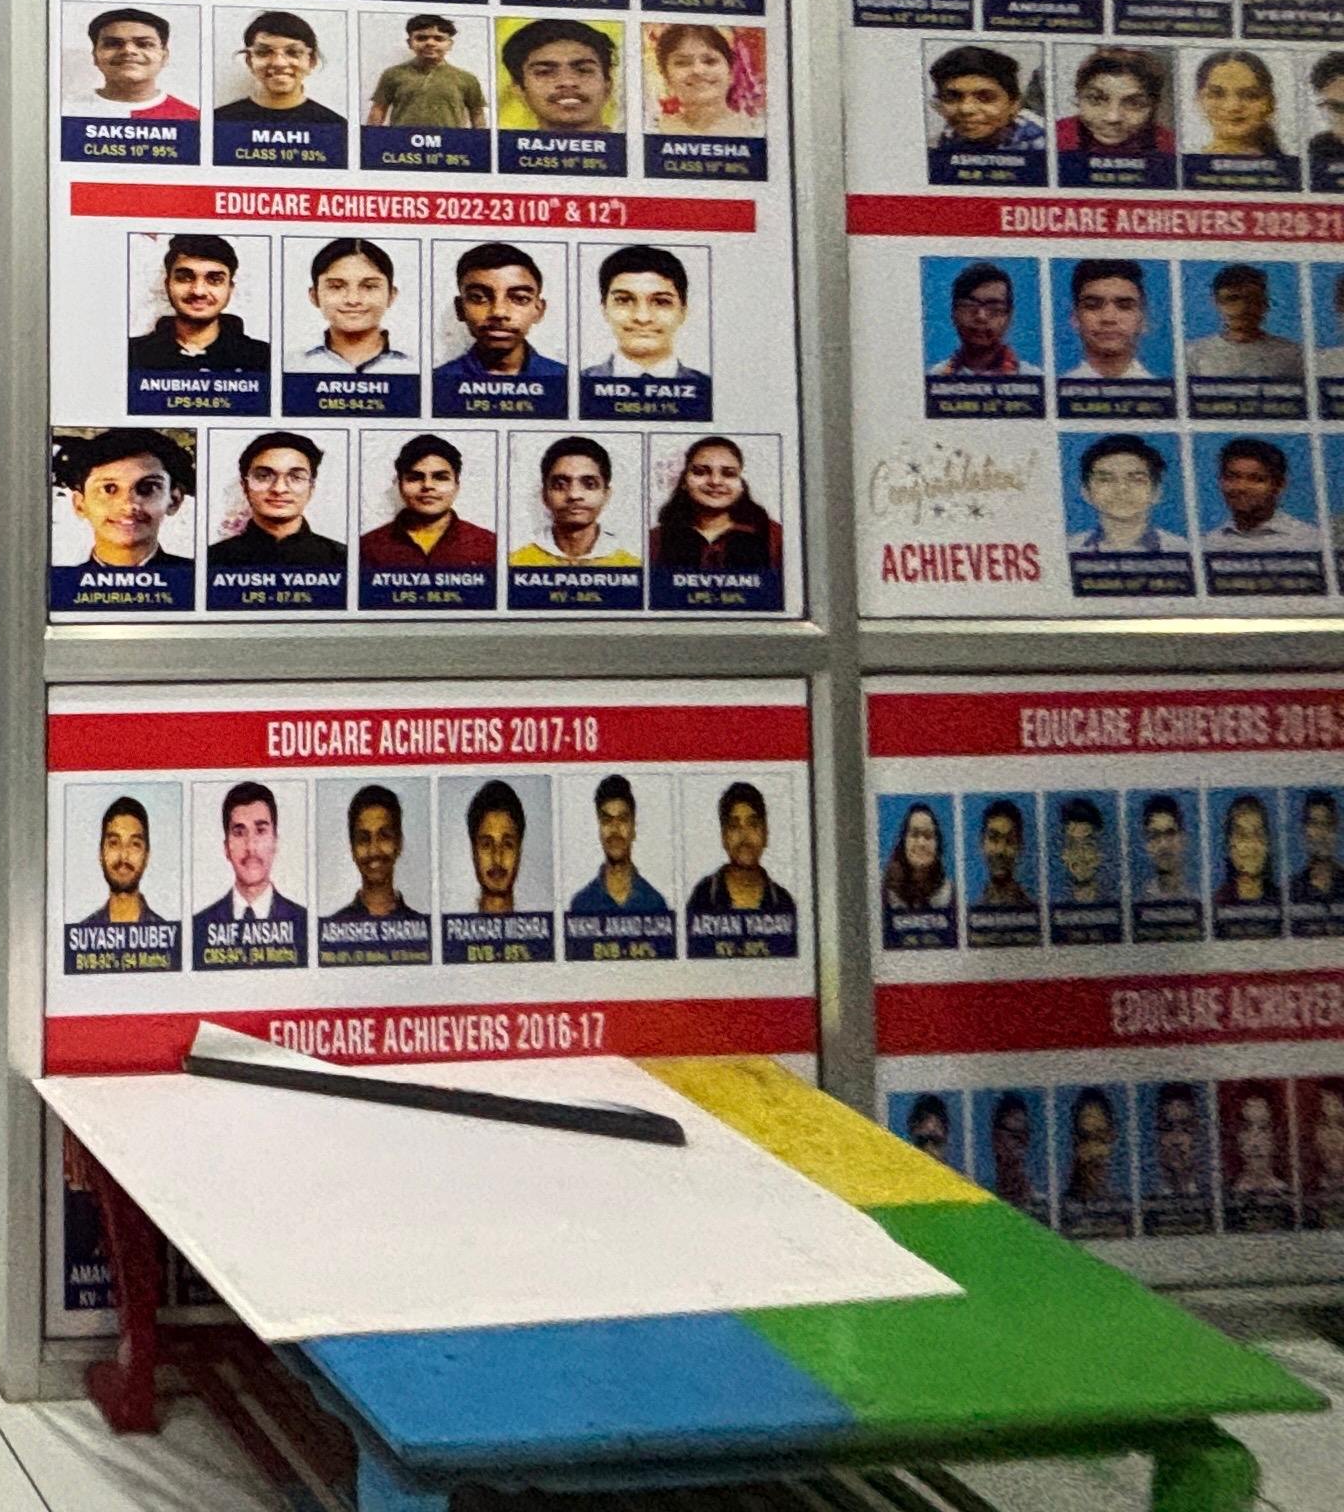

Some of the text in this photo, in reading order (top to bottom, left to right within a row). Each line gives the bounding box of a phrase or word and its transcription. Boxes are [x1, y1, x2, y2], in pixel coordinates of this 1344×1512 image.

[85, 124, 177, 140] SAKSHAM
[251, 129, 310, 144] MAHI
[411, 134, 442, 148] OM
[517, 138, 607, 154] RAJVEER
[83, 143, 126, 156] CLASS
[235, 148, 276, 161] CLASS
[662, 142, 751, 158] ANVESHA
[382, 152, 422, 165] CLASS
[519, 156, 559, 169] CLASS
[215, 191, 310, 216] EDUCARE
[317, 194, 429, 219] ACHIEVERS
[436, 197, 514, 221] 2022-23
[565, 201, 580, 222] &
[1000, 206, 1108, 234] EDUCARE
[1116, 208, 1246, 236] ACHIEVERS
[139, 378, 259, 393] ANUBHAV SINGH
[316, 380, 390, 395] ARUSHI
[458, 382, 544, 397] ANURAG
[594, 383, 697, 399] MD. FAIZ
[882, 543, 1041, 583] ACHIEVERS
[79, 572, 168, 587] ANMOL
[213, 572, 342, 587] AYUSH YADAV
[372, 572, 485, 587] ATULYA SINGH
[513, 572, 638, 587] KALPADRUM
[672, 573, 761, 588] DEVYANI
[1020, 706, 1132, 747] EDUCARE
[267, 715, 598, 757] EDUCARE ACHIEVERS 2017-18
[69, 924, 179, 951] SUYASH DUBEY
[207, 921, 294, 946] SAIF ANSARI
[269, 1012, 605, 1057] EDUCARE ACHIEVERS 2016-17
